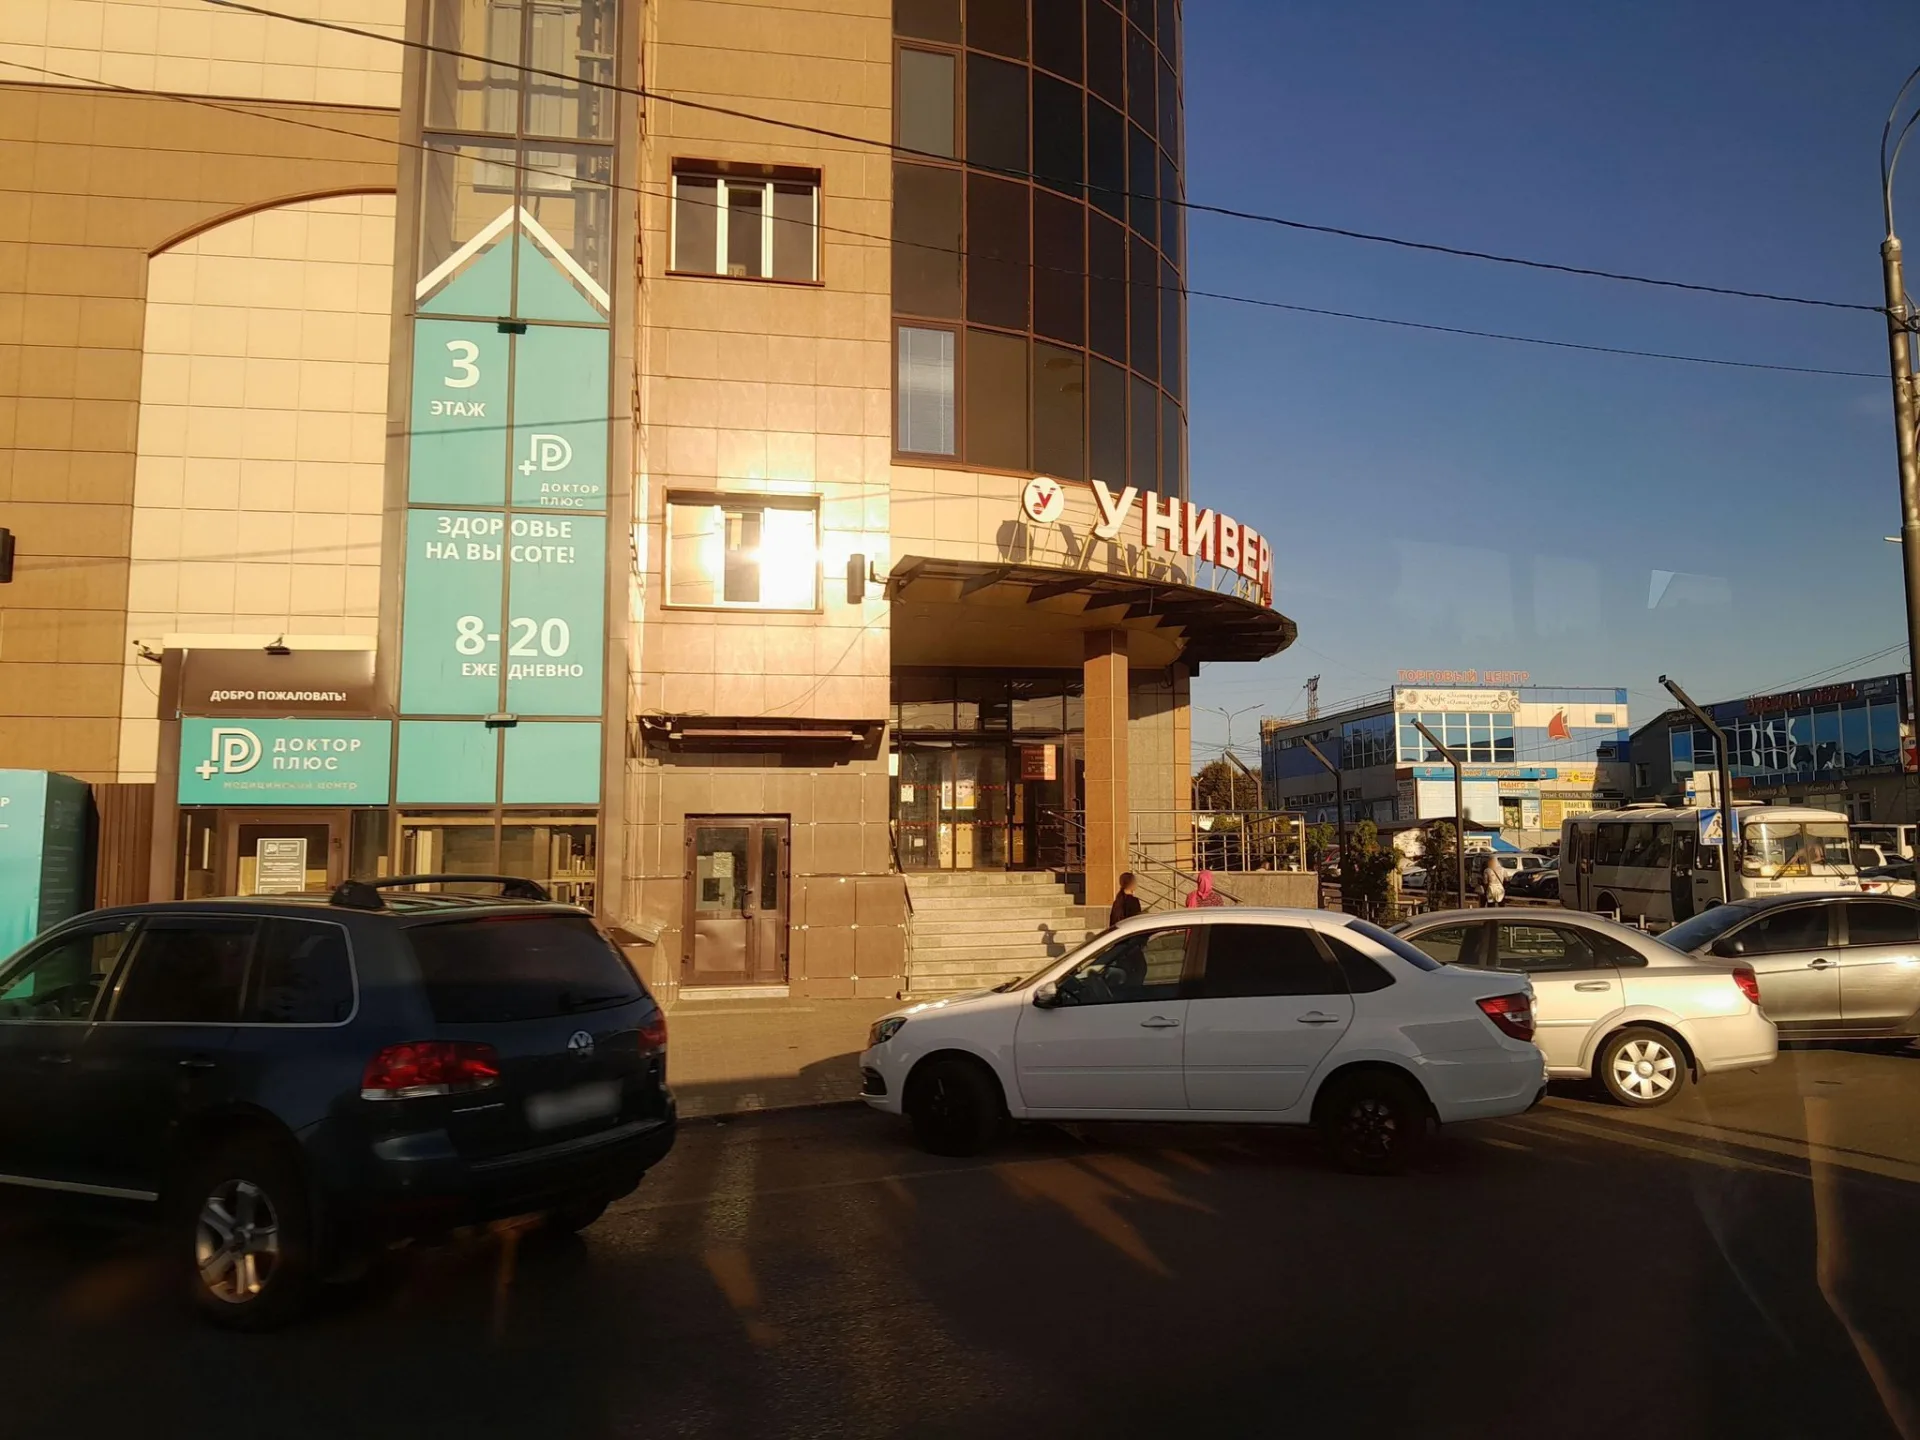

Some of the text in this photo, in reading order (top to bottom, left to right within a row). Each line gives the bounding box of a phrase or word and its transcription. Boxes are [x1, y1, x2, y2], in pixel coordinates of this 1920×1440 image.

[444, 340, 481, 388] 3
[430, 401, 486, 417] ЭТАЖ
[540, 482, 600, 495] ДОКТОР
[539, 496, 584, 508] ПЛЮС
[436, 516, 572, 540] ЗДОРОВЬЕ
[426, 542, 575, 564] НА ВЫСОТЕ!
[461, 662, 584, 681] ЕЖЕДНЕВНО
[1396, 668, 1529, 684] ТОРГОВЫЙ ЦЕНТР
[210, 689, 347, 703] ДОБРО ПОЖАЛОВАТЬ!
[272, 737, 363, 753] ДОКТОР
[272, 757, 339, 770] ПЛЮС
